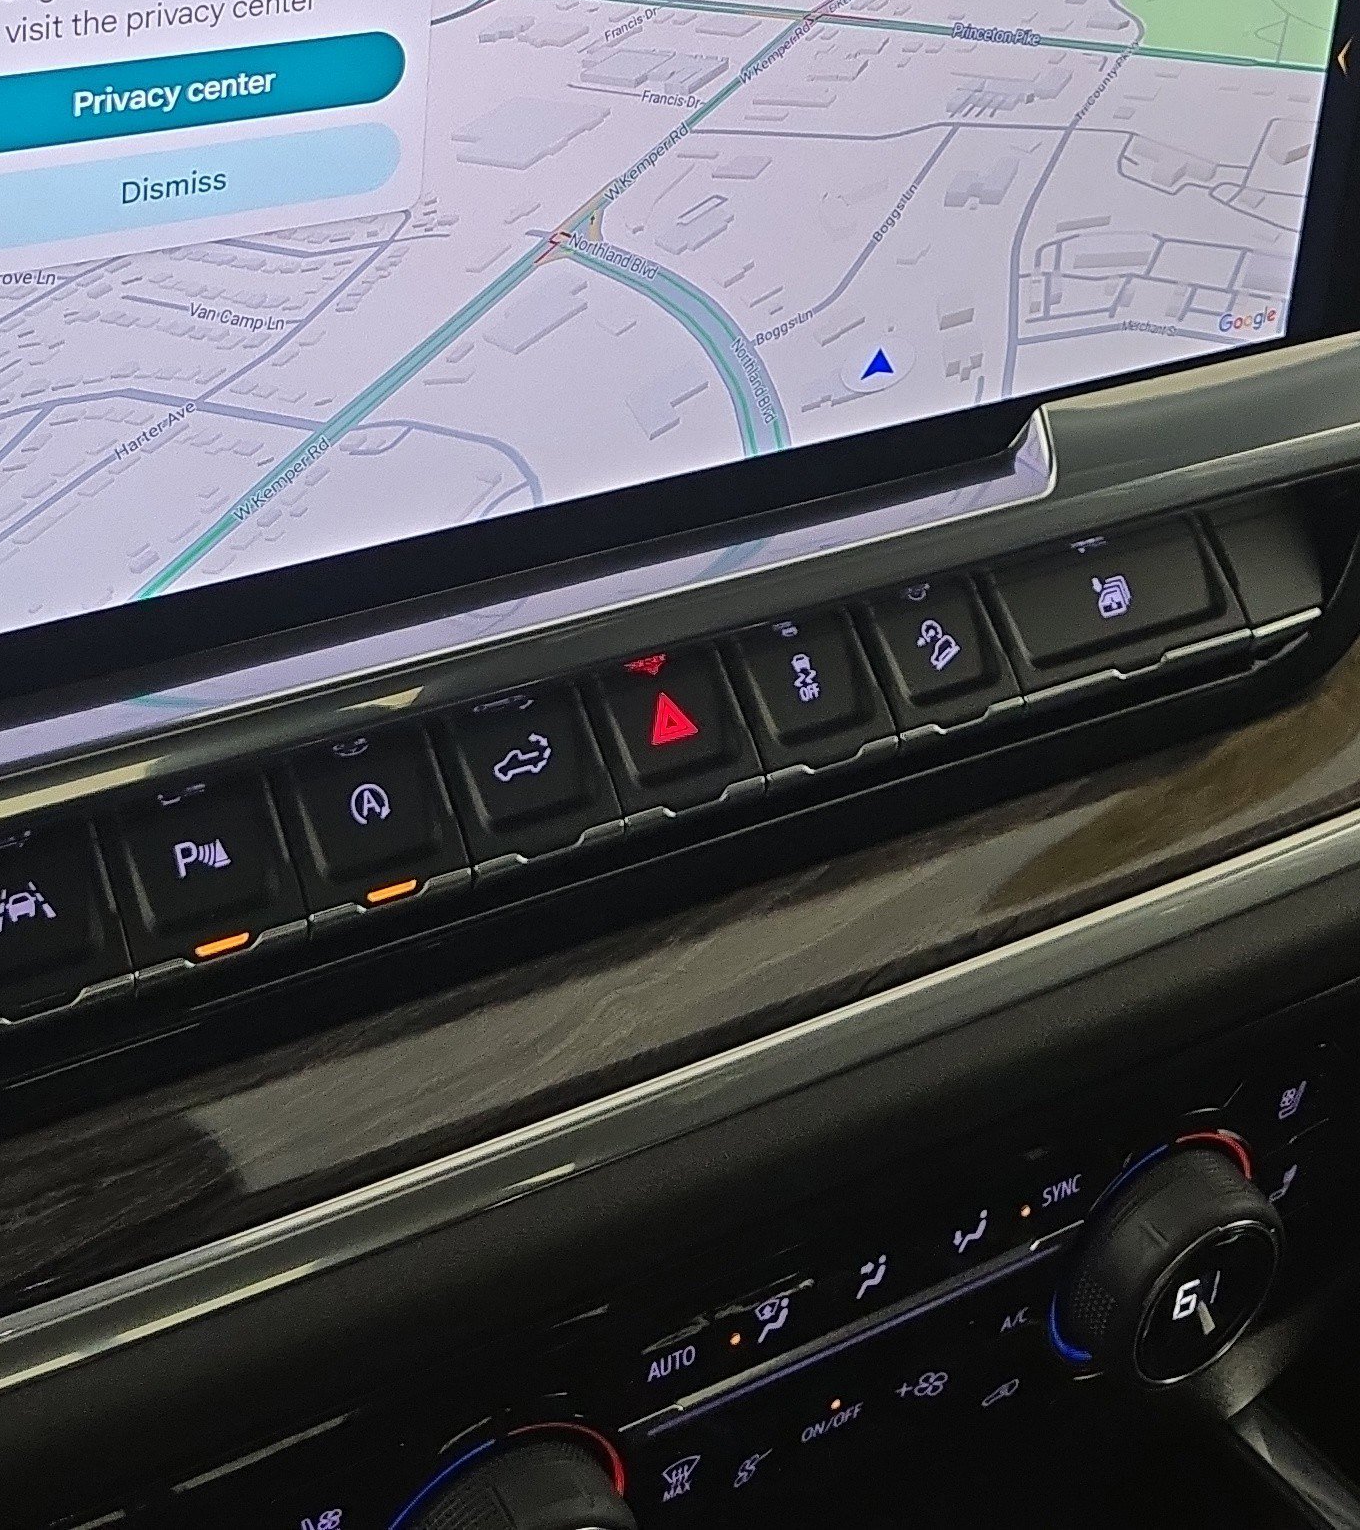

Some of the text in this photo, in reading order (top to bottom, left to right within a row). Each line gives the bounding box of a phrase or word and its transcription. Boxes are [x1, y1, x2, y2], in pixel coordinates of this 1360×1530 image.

[5, 17, 63, 45] visit
[72, 8, 117, 37] the
[126, 0, 225, 33] privacy
[604, 6, 658, 42] Francis Dr
[952, 23, 1041, 47] Princeton Pike
[739, 23, 811, 84] W Kemper Rd
[72, 72, 277, 118] Privacy center
[641, 89, 702, 109] Francis Dr
[1087, 67, 1119, 106] County
[604, 122, 689, 201] W Kemper Rd
[122, 169, 228, 204] Dismiss
[873, 182, 919, 243] Boggs Ln
[569, 232, 658, 280] Northland Blvd
[34, 269, 57, 286] Ln
[189, 303, 286, 332] Van Camp Ln
[755, 308, 813, 346] Boggs Ln
[1218, 305, 1277, 332] Google
[730, 337, 776, 424] Northland Blvd
[114, 401, 196, 462] Harter Ave
[232, 436, 330, 522] W Kemper Rd
[1041, 1173, 1082, 1208] SYNC
[646, 1345, 696, 1383] AUTO
[800, 1401, 864, 1444] ON/OFF
[662, 1481, 691, 1503] MAX
